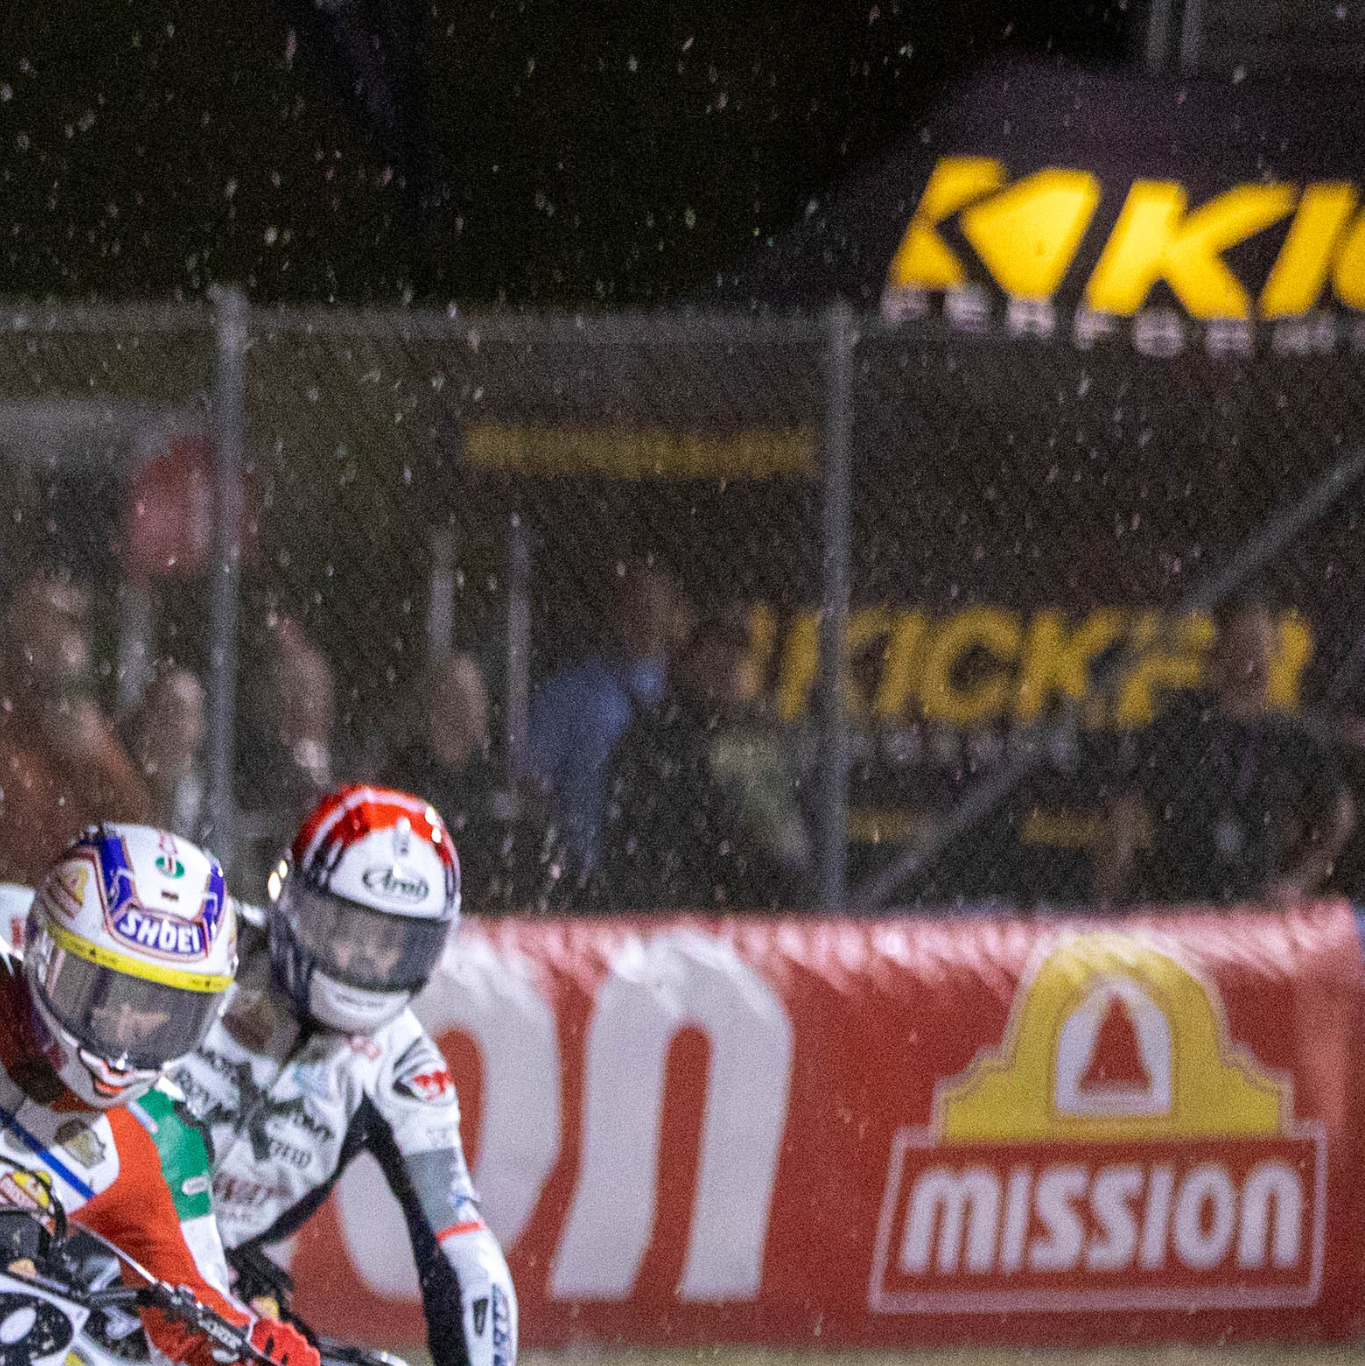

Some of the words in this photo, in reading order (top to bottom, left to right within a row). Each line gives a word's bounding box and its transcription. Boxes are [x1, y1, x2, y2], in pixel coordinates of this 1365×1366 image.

[1085, 180, 1365, 320] KI
[119, 908, 202, 953] SHOEI
[899, 1161, 1304, 1276] MISSION
